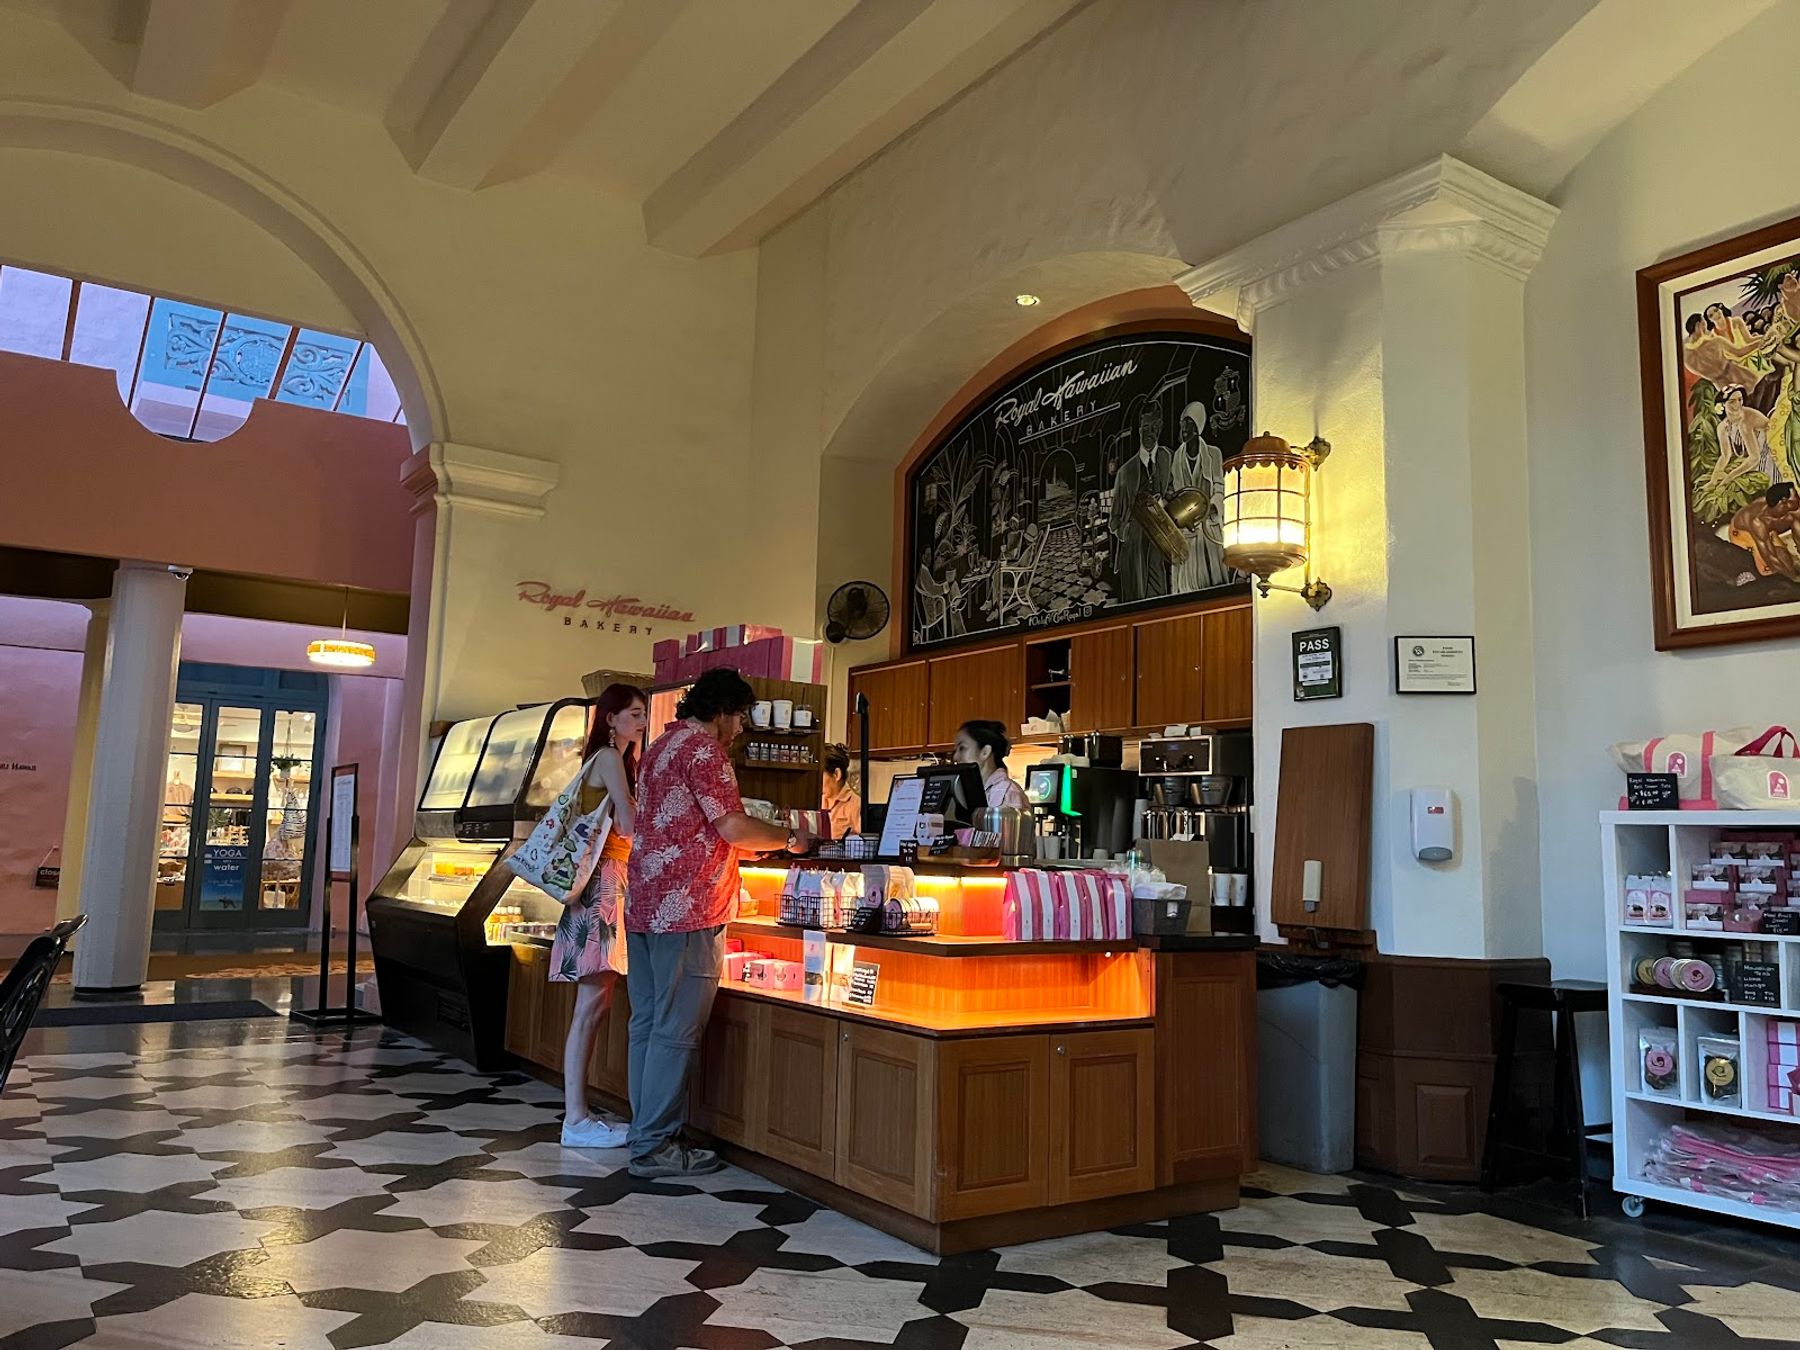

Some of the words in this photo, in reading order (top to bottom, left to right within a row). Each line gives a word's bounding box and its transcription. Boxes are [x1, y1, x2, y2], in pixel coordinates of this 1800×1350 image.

[994, 387, 1043, 429] Royal
[1041, 359, 1138, 410] Hawaiian
[1026, 400, 1097, 436] BAKERY
[515, 581, 586, 611] Royal
[587, 594, 696, 623] Hawaiian
[563, 616, 653, 636] BAKERY
[1299, 638, 1330, 652] PASS
[213, 849, 242, 858] YOGA
[213, 863, 240, 871] water
